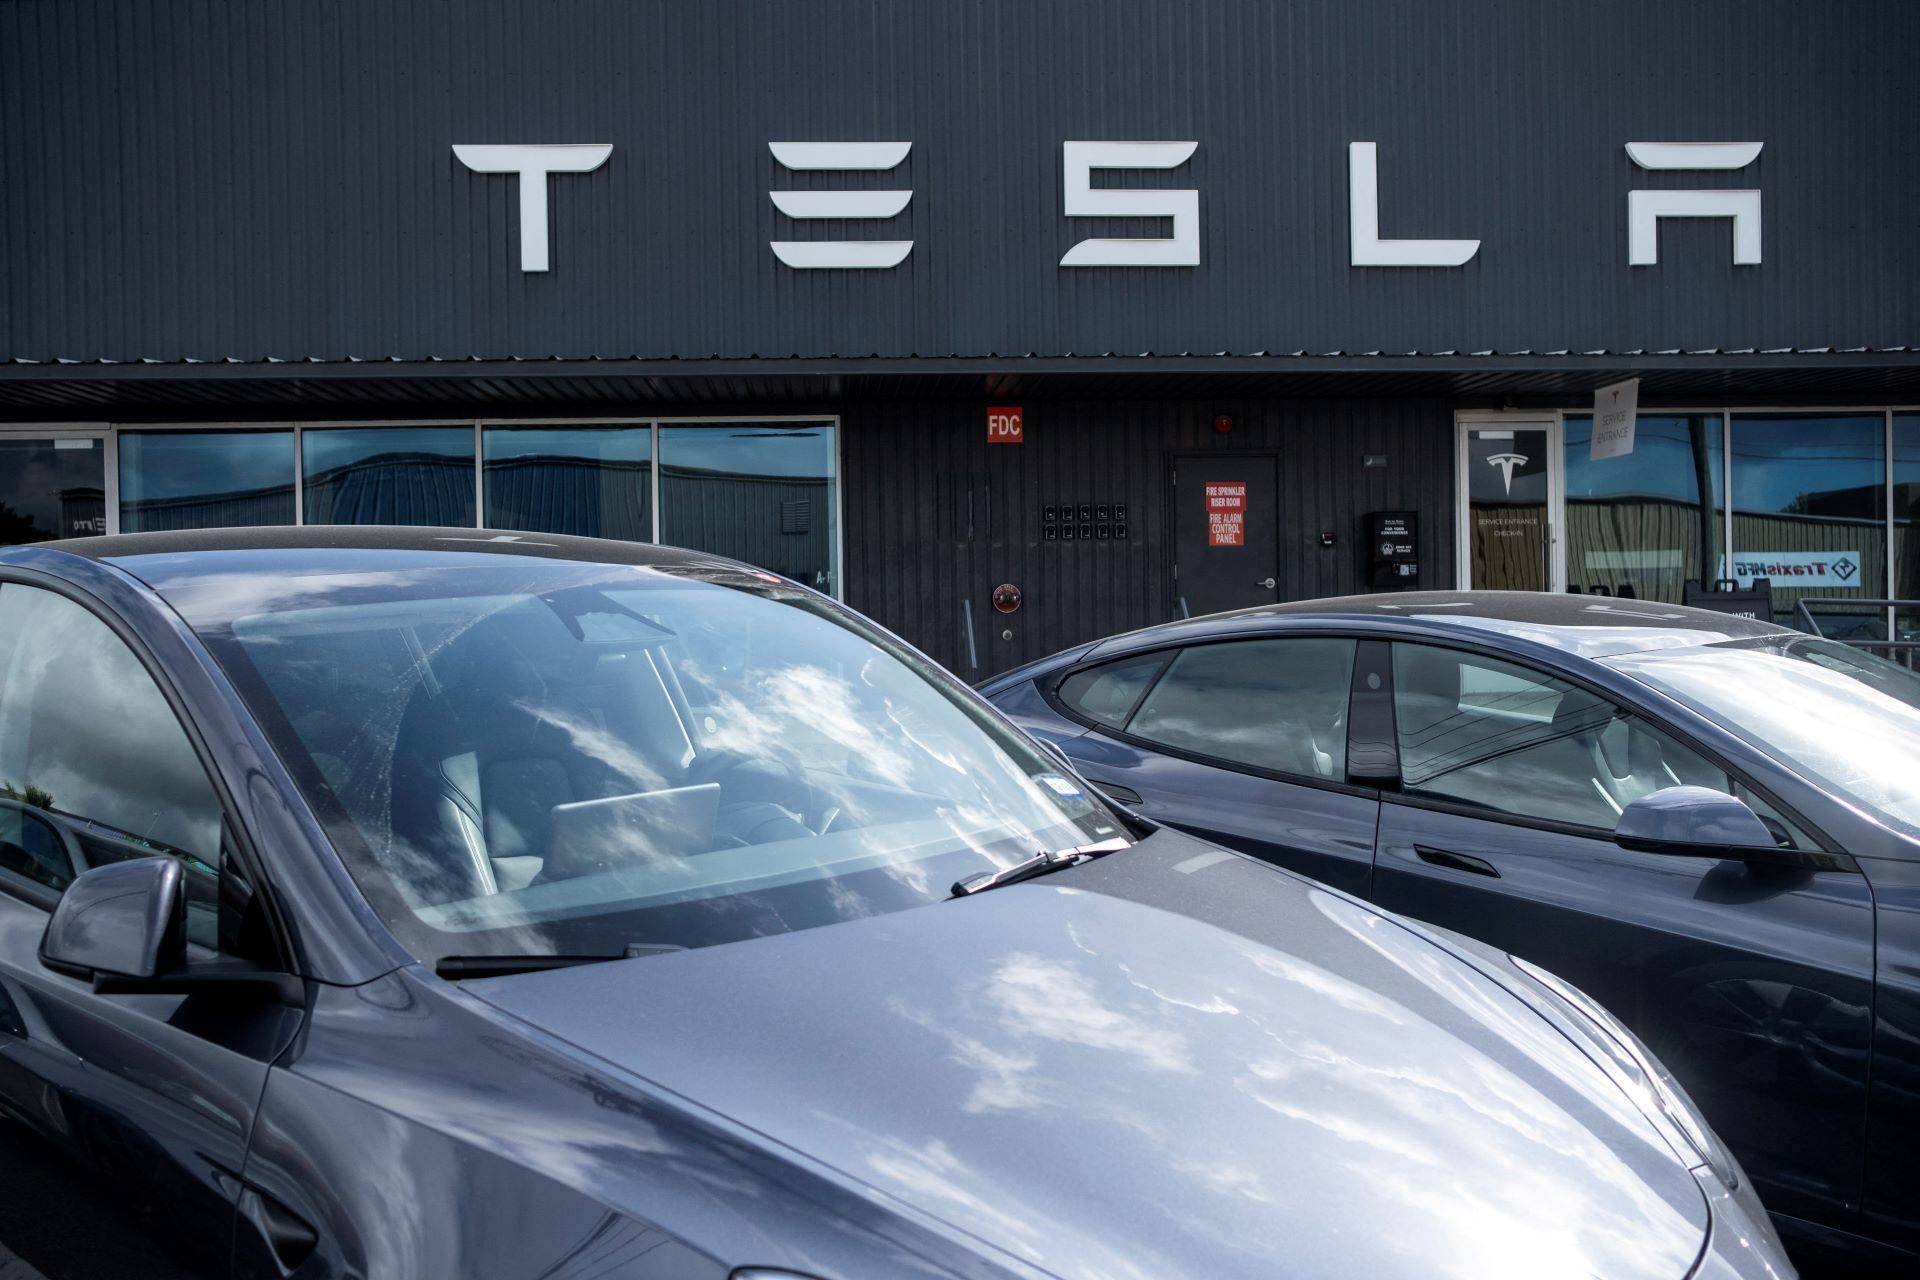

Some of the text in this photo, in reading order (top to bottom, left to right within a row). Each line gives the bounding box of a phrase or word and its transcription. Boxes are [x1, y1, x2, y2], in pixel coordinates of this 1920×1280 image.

[452, 141, 1764, 271] TESLA
[989, 415, 1020, 435] FDC
[1206, 486, 1245, 496] FIRE SPRINKLER
[1211, 497, 1240, 506] RISER ROOM
[1210, 513, 1242, 523] FIRE ALARM
[1212, 523, 1240, 534] CONTROL
[1215, 534, 1236, 543] PANEL
